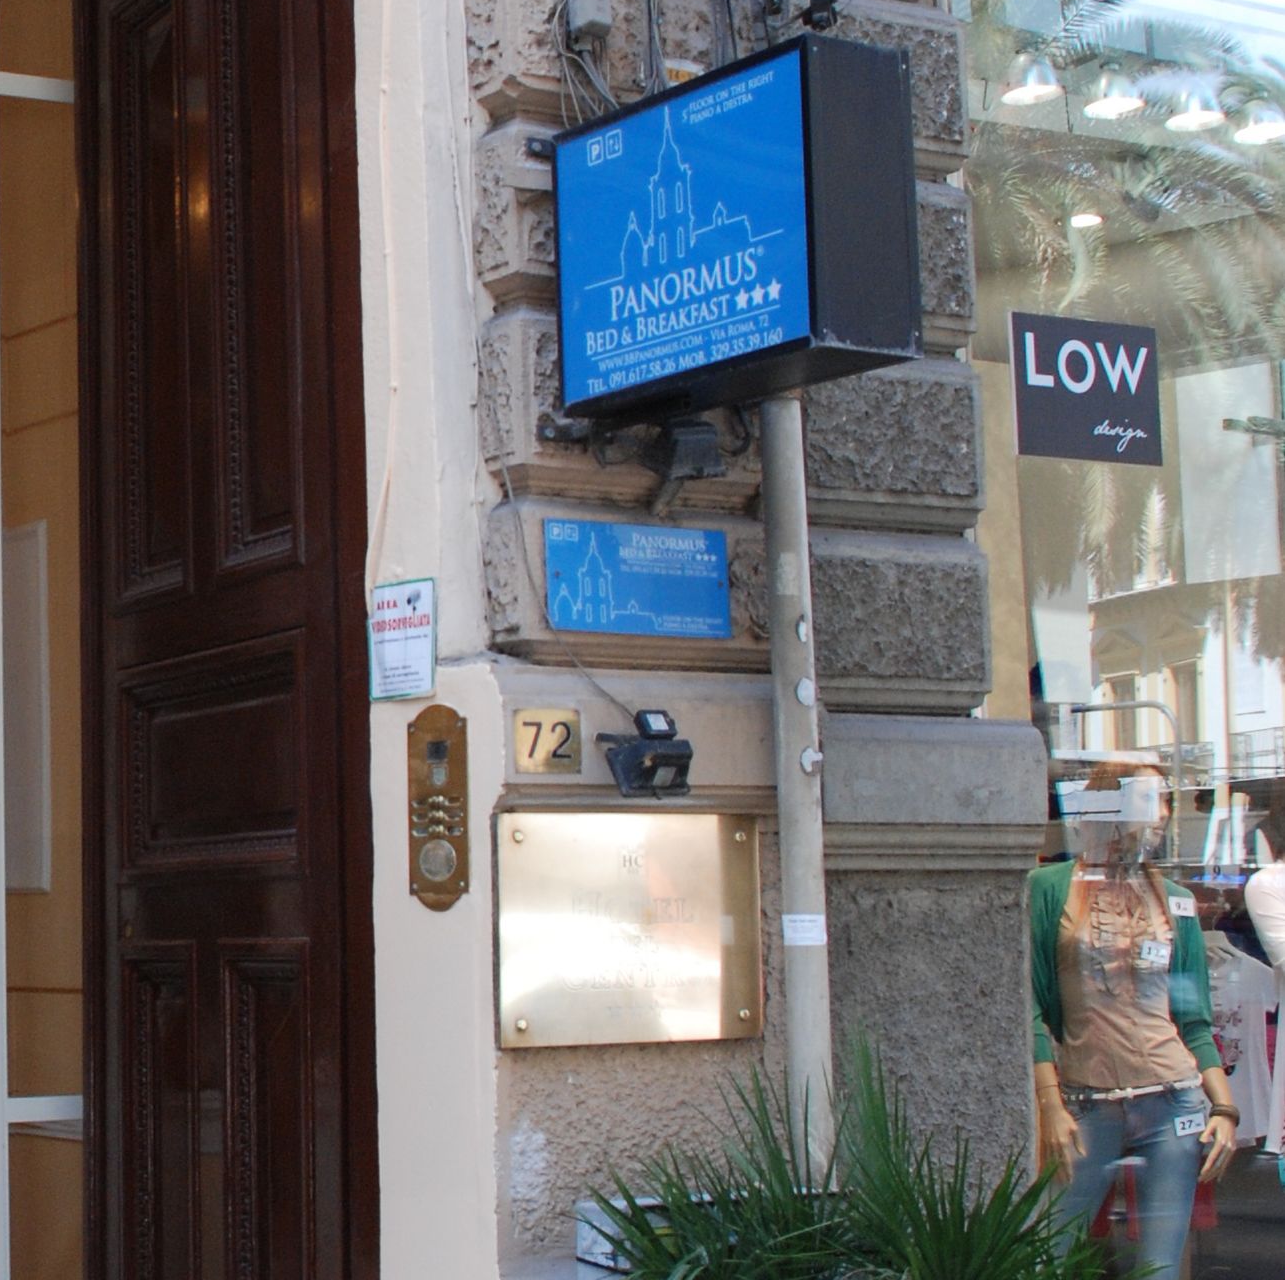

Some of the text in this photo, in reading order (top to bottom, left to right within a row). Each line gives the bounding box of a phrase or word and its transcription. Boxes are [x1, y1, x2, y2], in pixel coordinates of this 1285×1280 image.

[716, 89, 729, 102] ON
[621, 325, 634, 346] &
[1025, 331, 1148, 396] LOW
[1093, 418, 1148, 453] design
[522, 721, 572, 759] 72
